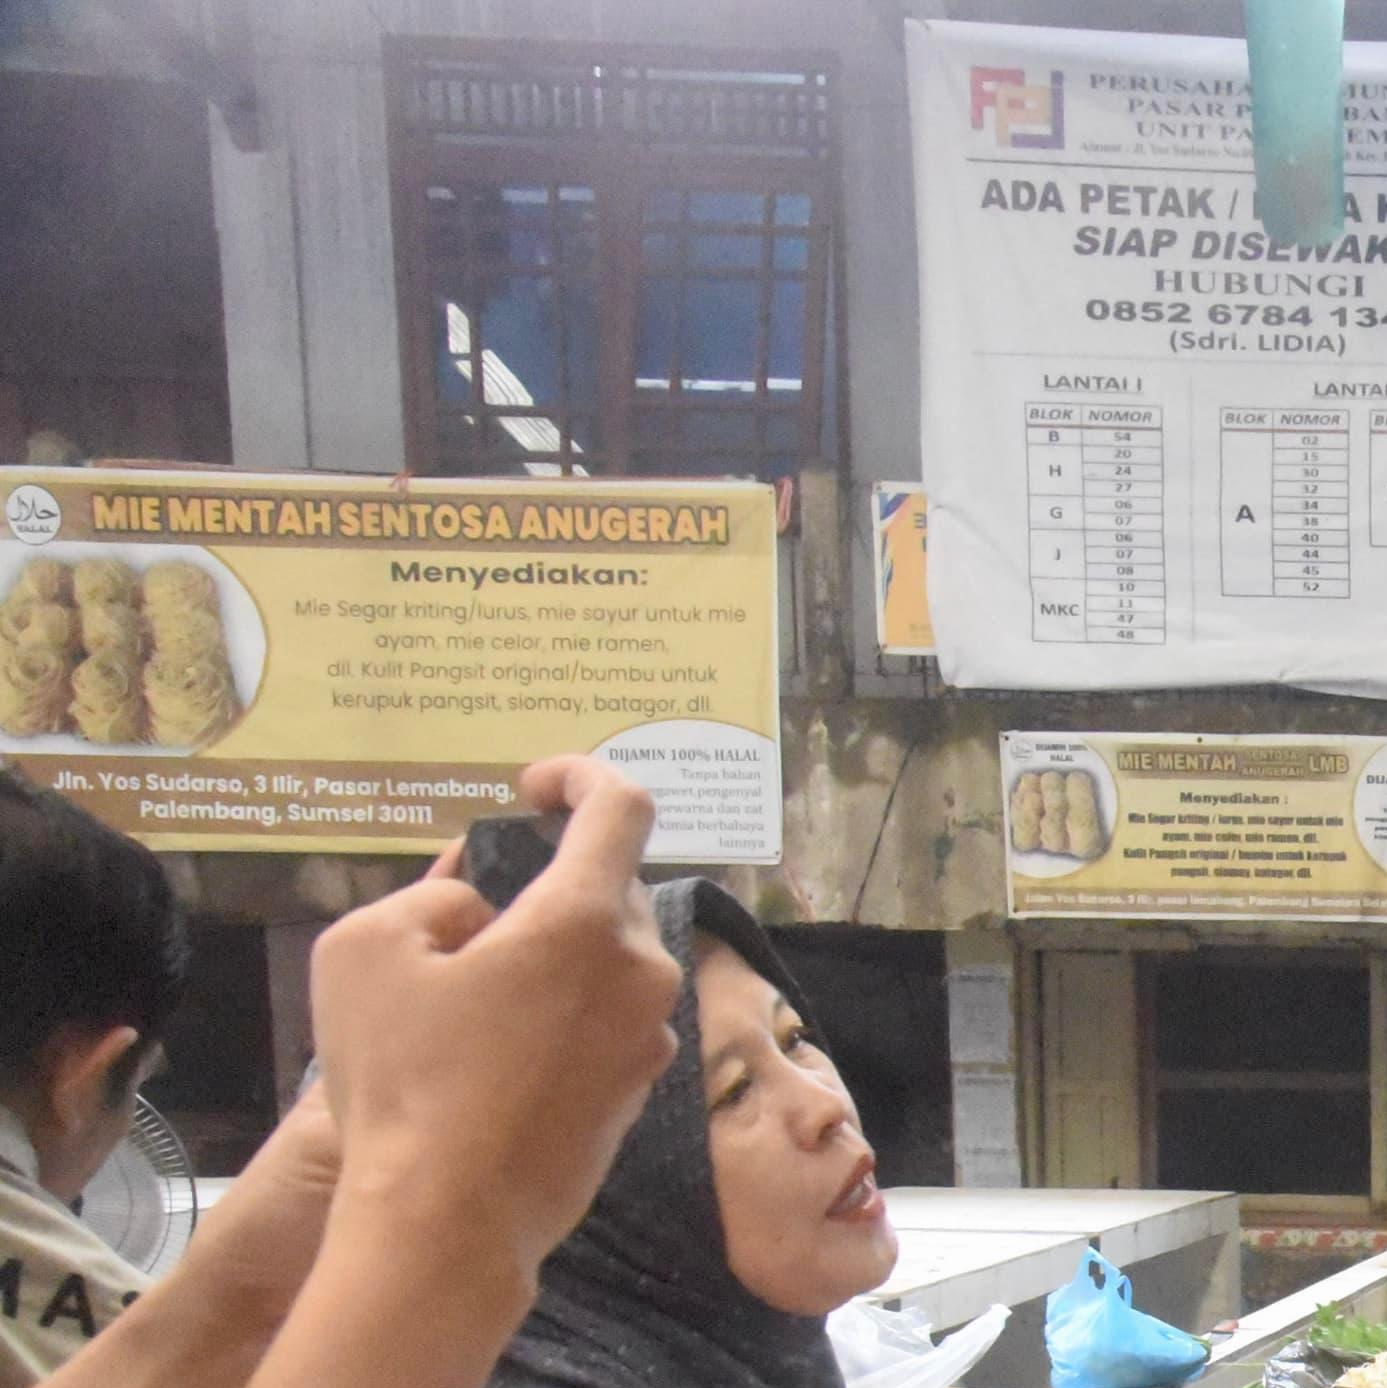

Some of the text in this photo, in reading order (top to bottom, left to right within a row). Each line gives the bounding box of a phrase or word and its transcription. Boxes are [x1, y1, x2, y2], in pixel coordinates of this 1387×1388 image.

[1090, 73, 1254, 98] PERUSAHA
[1128, 98, 1226, 118] PASAR
[1137, 121, 1212, 139] UNIT
[981, 179, 1065, 213] ADA
[1080, 183, 1215, 219] PETAK
[1073, 225, 1178, 257] SIAP
[1154, 269, 1365, 298] HUBUNGI
[1086, 299, 1193, 323] 0852
[1207, 303, 1313, 327] 6784
[1169, 330, 1346, 357] (Sdri. LIDIA)
[1043, 374, 1128, 391] LANTAI
[1029, 408, 1153, 422] BLOK NOMOR
[1224, 412, 1340, 426] BLOK NOMOR
[1048, 430, 1060, 442] B
[1049, 464, 1132, 477] H 24
[93, 495, 729, 544] MIE MENTAH SENTOSA ANUGERAH
[1050, 506, 1063, 519] G
[1235, 504, 1256, 524] A
[1302, 549, 1319, 559] 44
[390, 561, 648, 590] Menyediakan:
[1118, 583, 1135, 592] 10
[295, 599, 331, 617] Mie
[336, 600, 398, 623] Segar
[537, 605, 576, 621] mie
[583, 605, 638, 627] sayur
[645, 605, 702, 622] untuk
[708, 606, 746, 622] mie
[1040, 603, 1080, 616] MKC
[446, 634, 485, 650] mie
[551, 635, 591, 651] mie
[361, 661, 403, 678] Kulit
[410, 662, 486, 685] Pangsit
[492, 660, 655, 686] original/bumbu
[661, 664, 718, 682] untuk
[332, 690, 413, 711] kerupuk
[508, 694, 588, 716] siomay,
[593, 695, 682, 718] batagor,
[609, 748, 761, 762] DIJAMIN 100% HALAL
[1118, 751, 1153, 771] MIE
[1158, 752, 1237, 772] MENTAH
[1309, 753, 1350, 774] LMB
[53, 771, 94, 790] Jln.
[98, 773, 140, 791] Yos
[146, 773, 249, 795] Sudarso,
[254, 774, 267, 792] 3
[314, 777, 382, 796] Pasar
[387, 778, 517, 803] Lemabang,
[1180, 792, 1280, 806] Menyediakan
[140, 799, 432, 826] Palembang, Sumsel 30111
